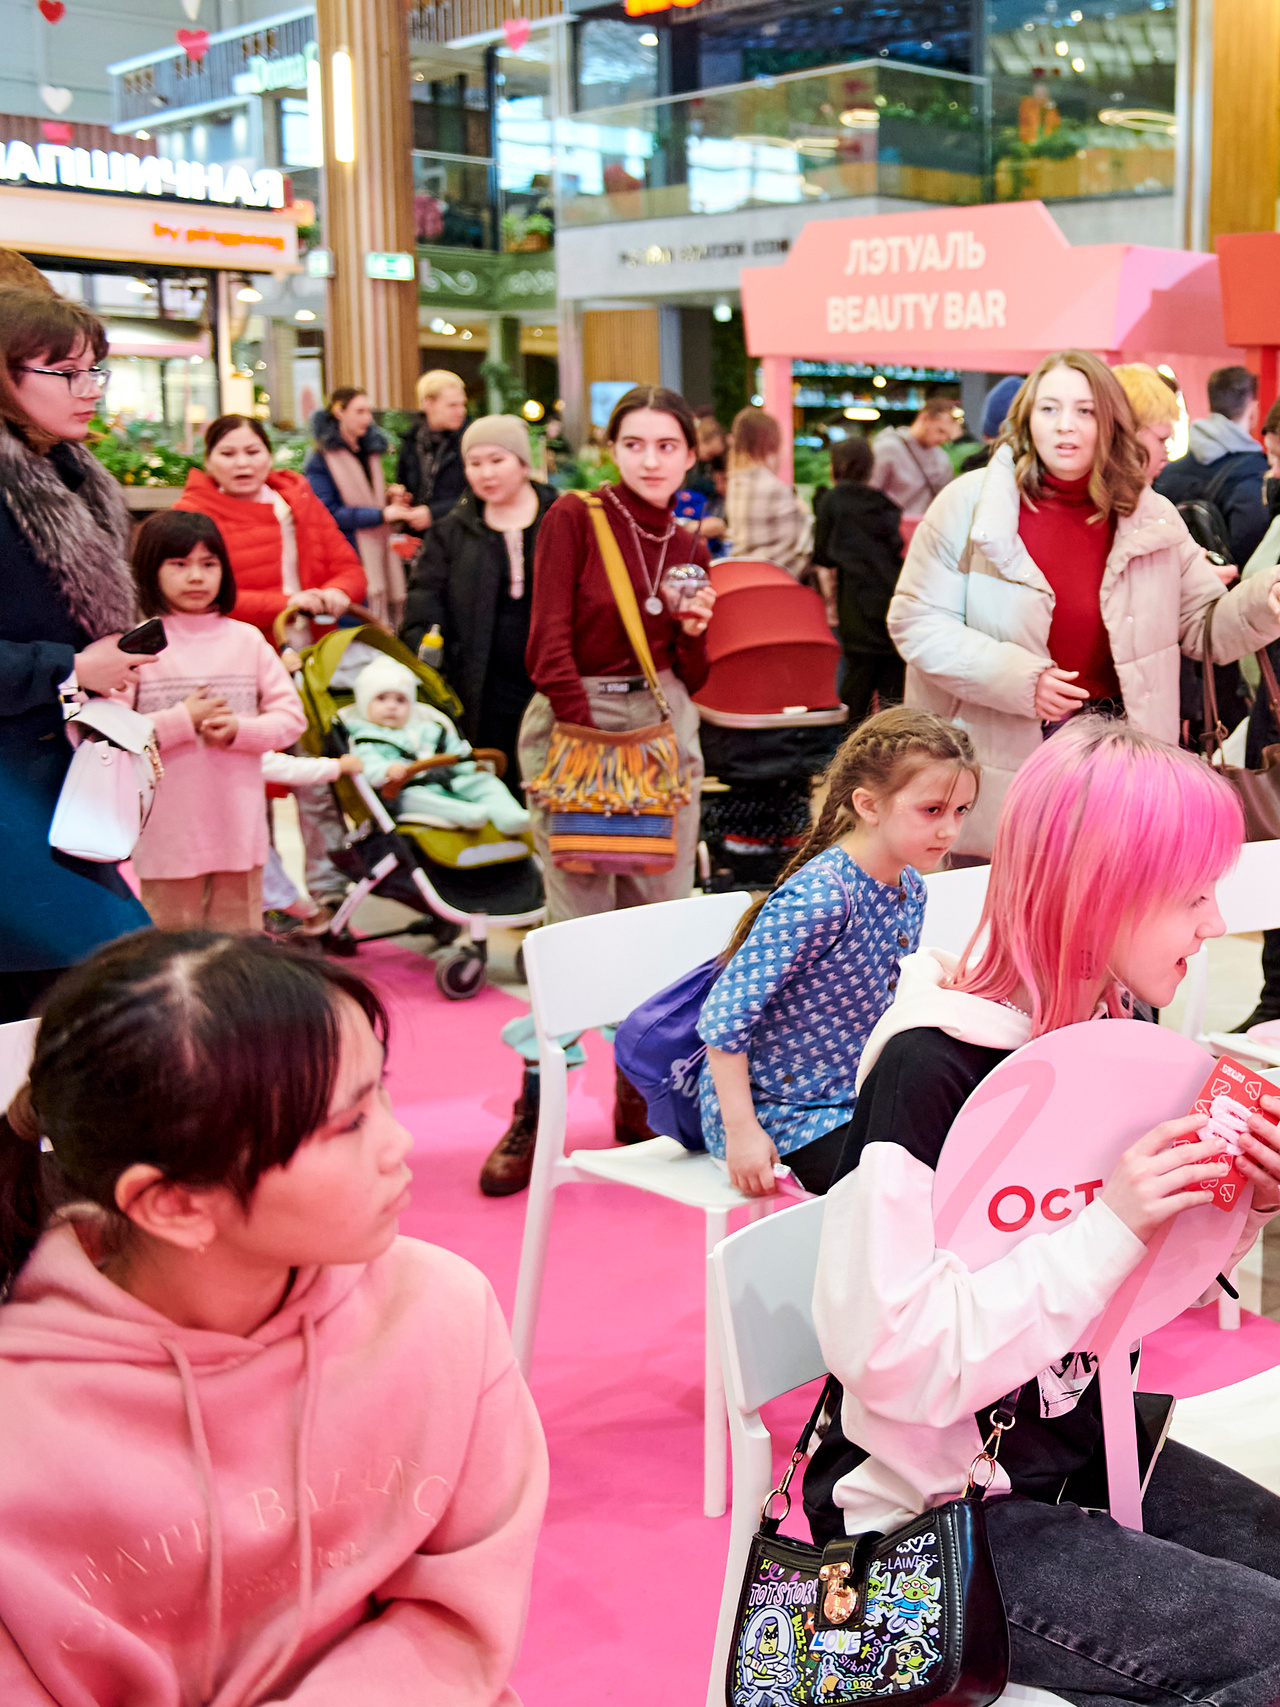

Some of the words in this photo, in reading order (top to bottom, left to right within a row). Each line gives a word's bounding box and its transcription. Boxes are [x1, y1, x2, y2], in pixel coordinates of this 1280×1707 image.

[0, 139, 285, 208] АПШИЧНАЯ
[844, 231, 986, 276] ЛЭТУАЛЬ
[827, 292, 939, 334] BEAUTY
[943, 289, 1007, 330] BAR
[809, 1629, 861, 1655] LOVE
